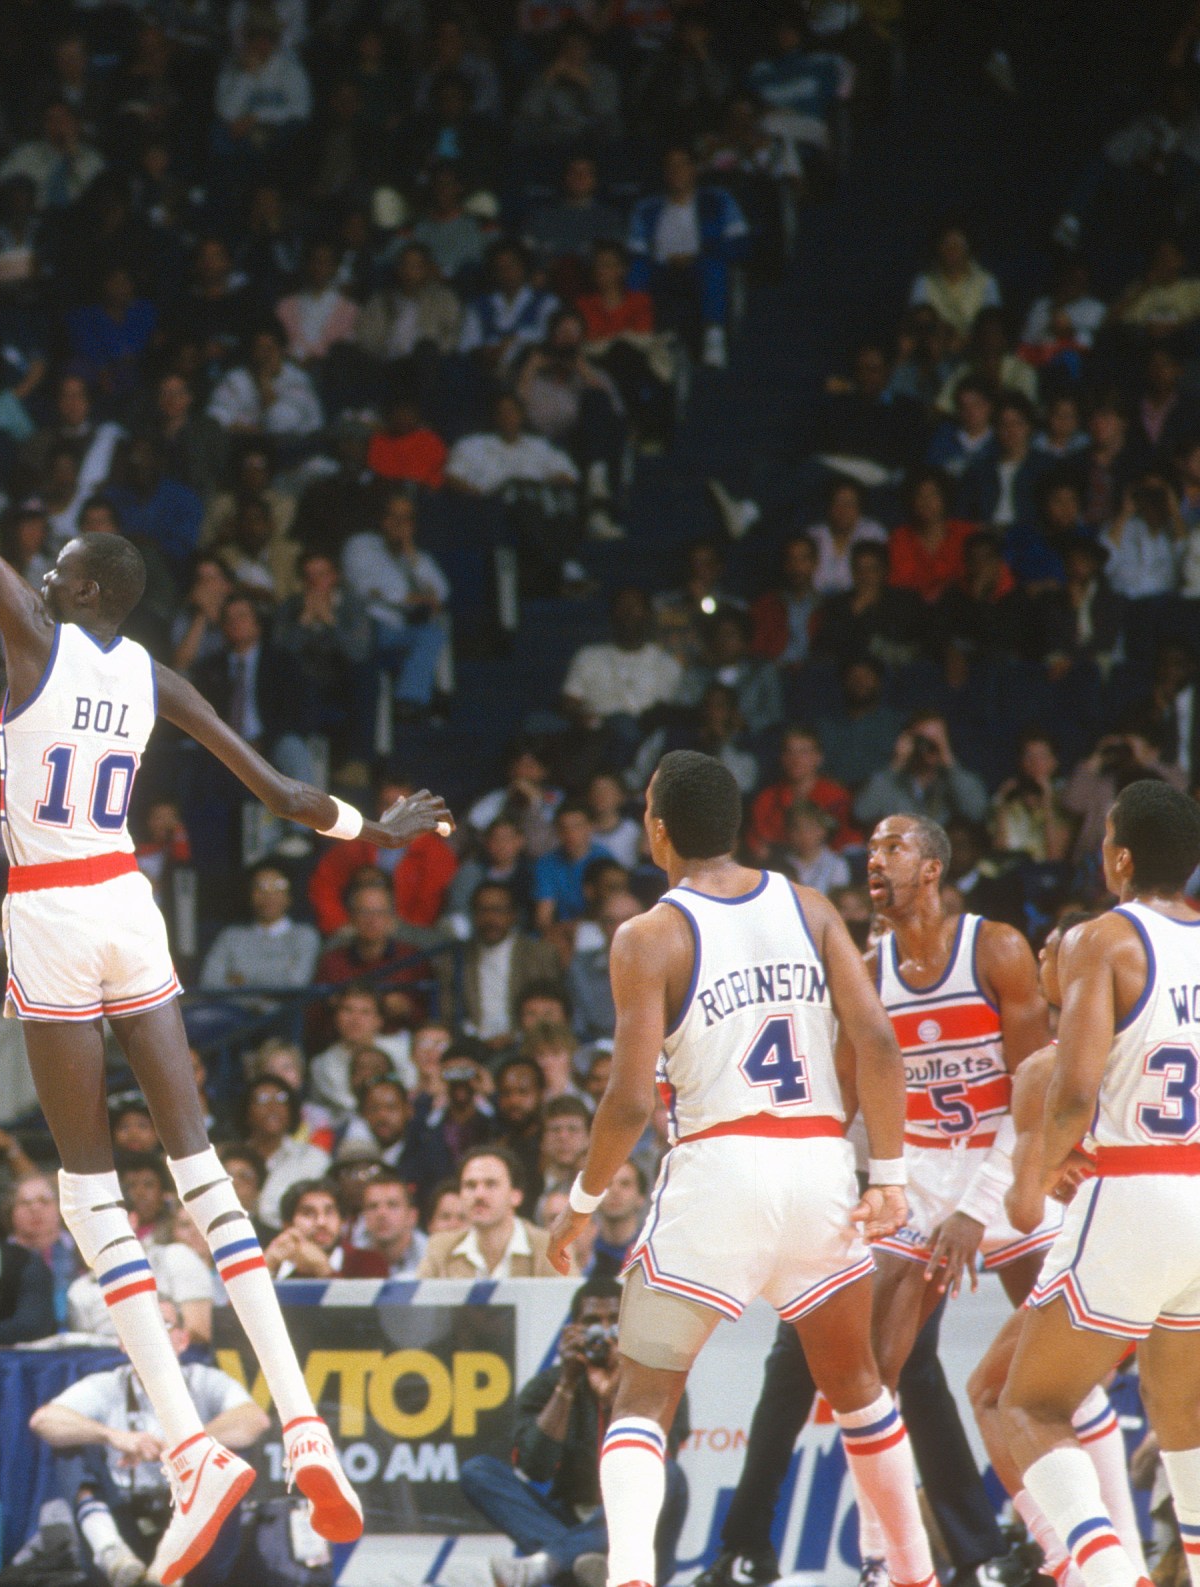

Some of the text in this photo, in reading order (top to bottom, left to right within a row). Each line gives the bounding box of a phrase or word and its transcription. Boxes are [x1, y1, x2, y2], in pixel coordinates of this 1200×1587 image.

[72, 697, 130, 738] BOL
[33, 742, 142, 834] 10
[697, 963, 828, 1027] ROBINSON
[738, 1013, 813, 1108] 4
[926, 1080, 979, 1138] 5
[382, 1443, 458, 1483] AM
